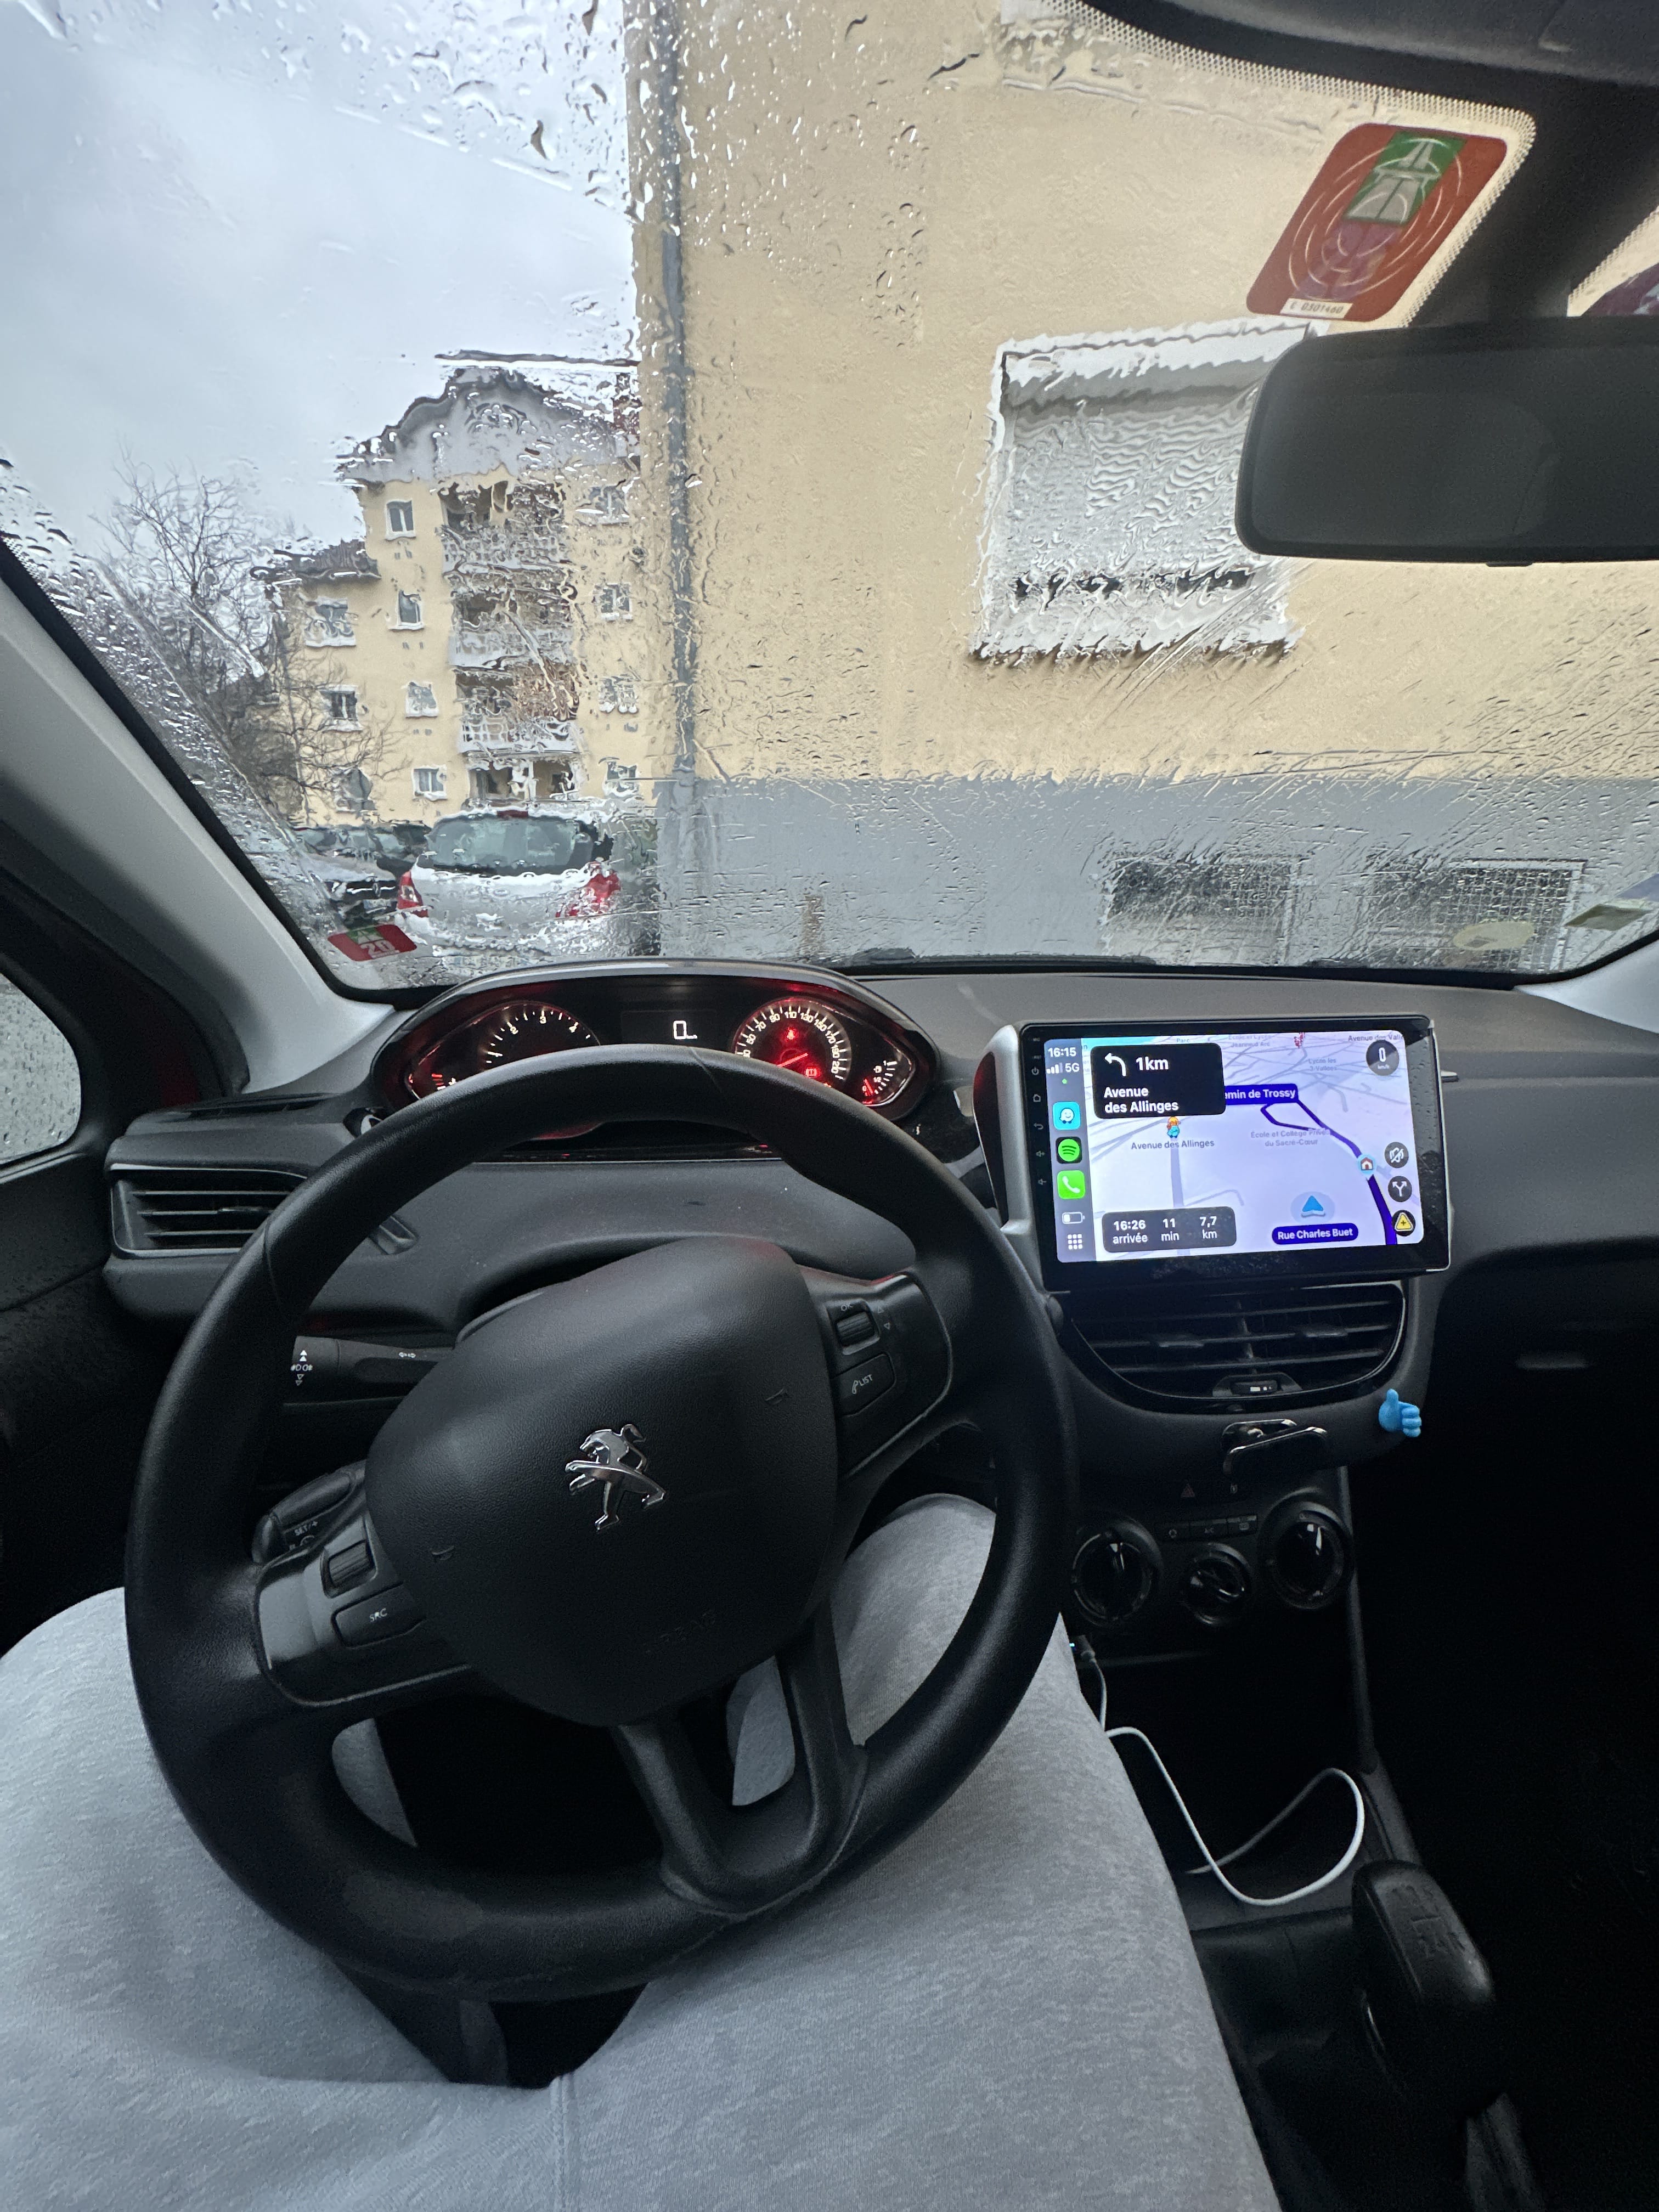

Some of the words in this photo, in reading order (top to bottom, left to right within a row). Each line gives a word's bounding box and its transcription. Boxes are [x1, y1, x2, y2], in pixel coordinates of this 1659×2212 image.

[360, 940, 395, 955] 20
[769, 1013, 780, 1023] 90
[800, 1012, 814, 1023] 130
[510, 1026, 518, 1035] 2
[755, 1021, 766, 1031] 70
[814, 1019, 827, 1031] 150
[825, 1030, 836, 1043] 170
[1048, 1048, 1076, 1058] 16:15
[1379, 1047, 1386, 1062] 0
[1065, 1063, 1080, 1073] 5G
[1104, 1087, 1149, 1099] Avenue
[1248, 1090, 1261, 1098] de
[1263, 1089, 1295, 1099] Trossy
[1104, 1102, 1127, 1114] des
[1130, 1101, 1179, 1115] Allinges
[1131, 1141, 1163, 1150] Avenue
[1181, 1139, 1215, 1150] Allinges
[1113, 1220, 1146, 1231] 16:26
[1163, 1218, 1176, 1229] 11
[1199, 1216, 1217, 1228] 7,7
[1113, 1232, 1148, 1244] arrivée
[1161, 1231, 1180, 1242] min
[1202, 1229, 1217, 1240] km
[1278, 1231, 1295, 1240] Rue
[1296, 1229, 1330, 1239] Charles
[1332, 1227, 1353, 1238] Buet
[859, 1374, 873, 1386] LIST
[369, 1607, 387, 1622] SRC
